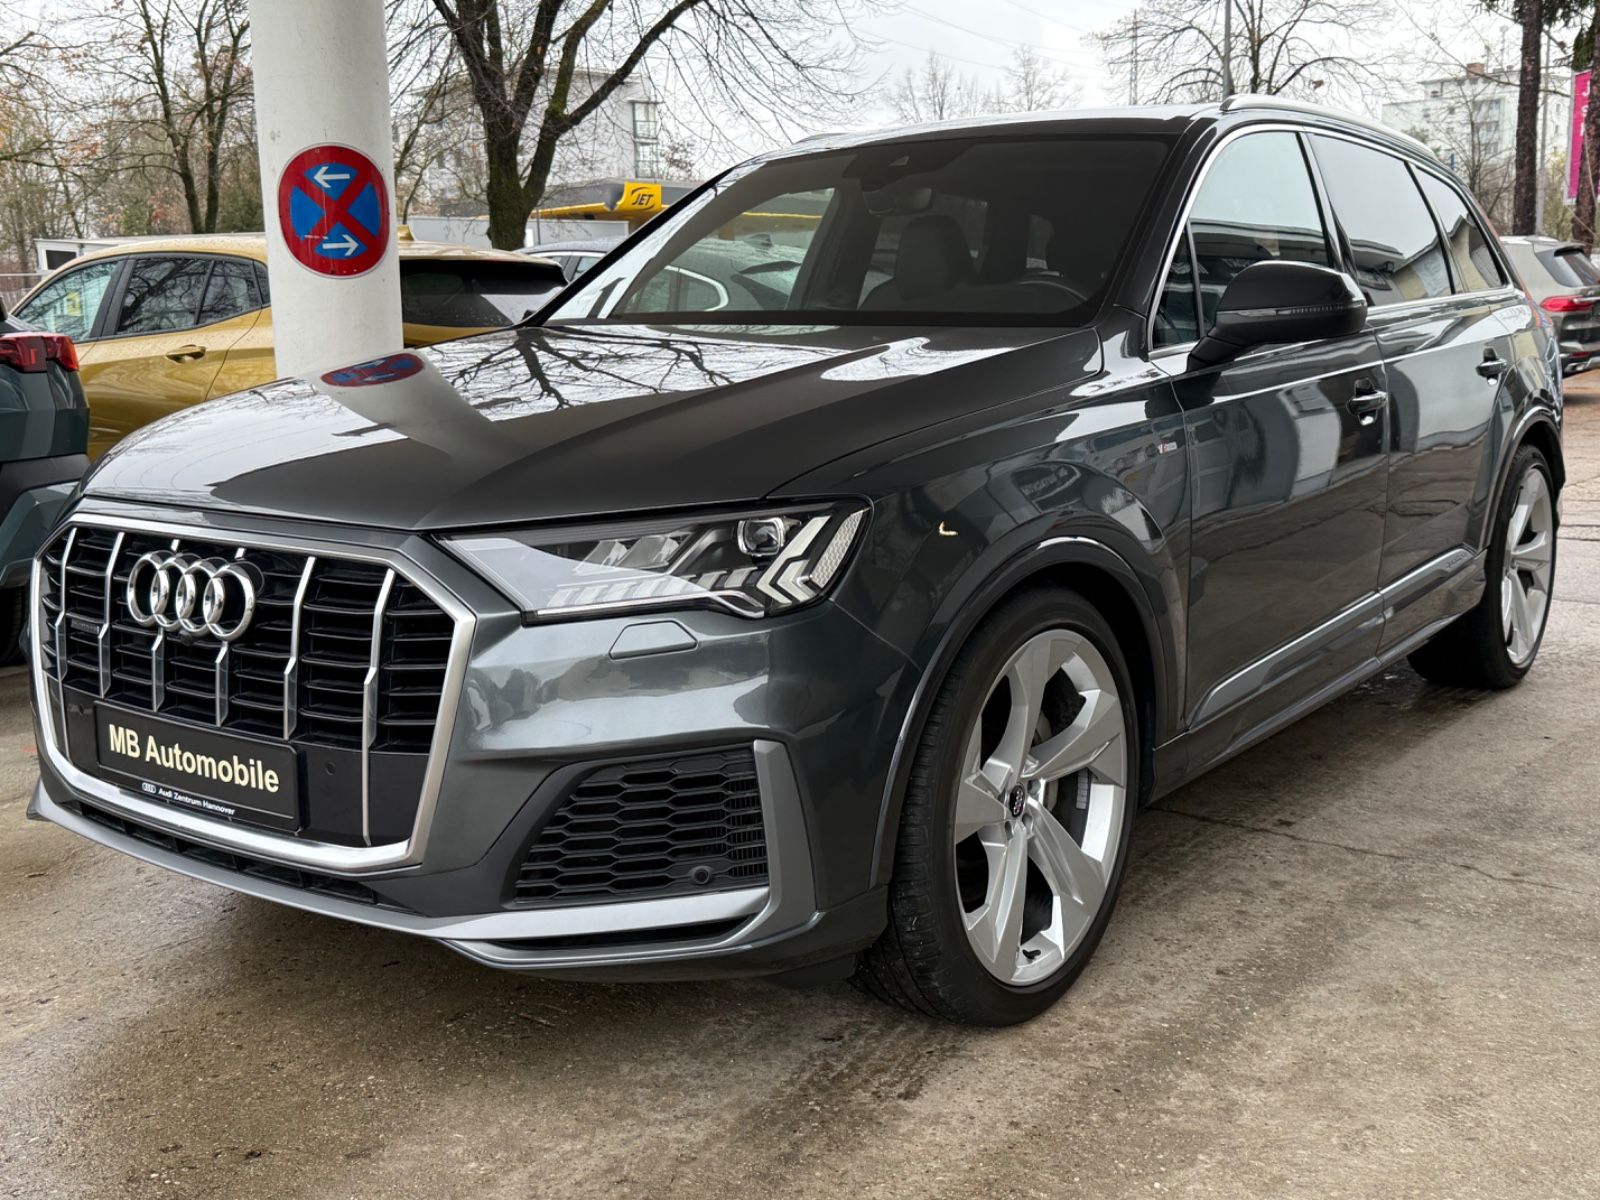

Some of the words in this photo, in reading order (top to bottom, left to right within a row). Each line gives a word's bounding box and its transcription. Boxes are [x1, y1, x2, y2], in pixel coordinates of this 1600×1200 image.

[632, 194, 654, 206] JET
[109, 724, 140, 758] MB
[145, 735, 279, 793] Automobile
[158, 788, 172, 798] Audi
[173, 792, 202, 806] Zentrum
[203, 800, 235, 815] Hannover
